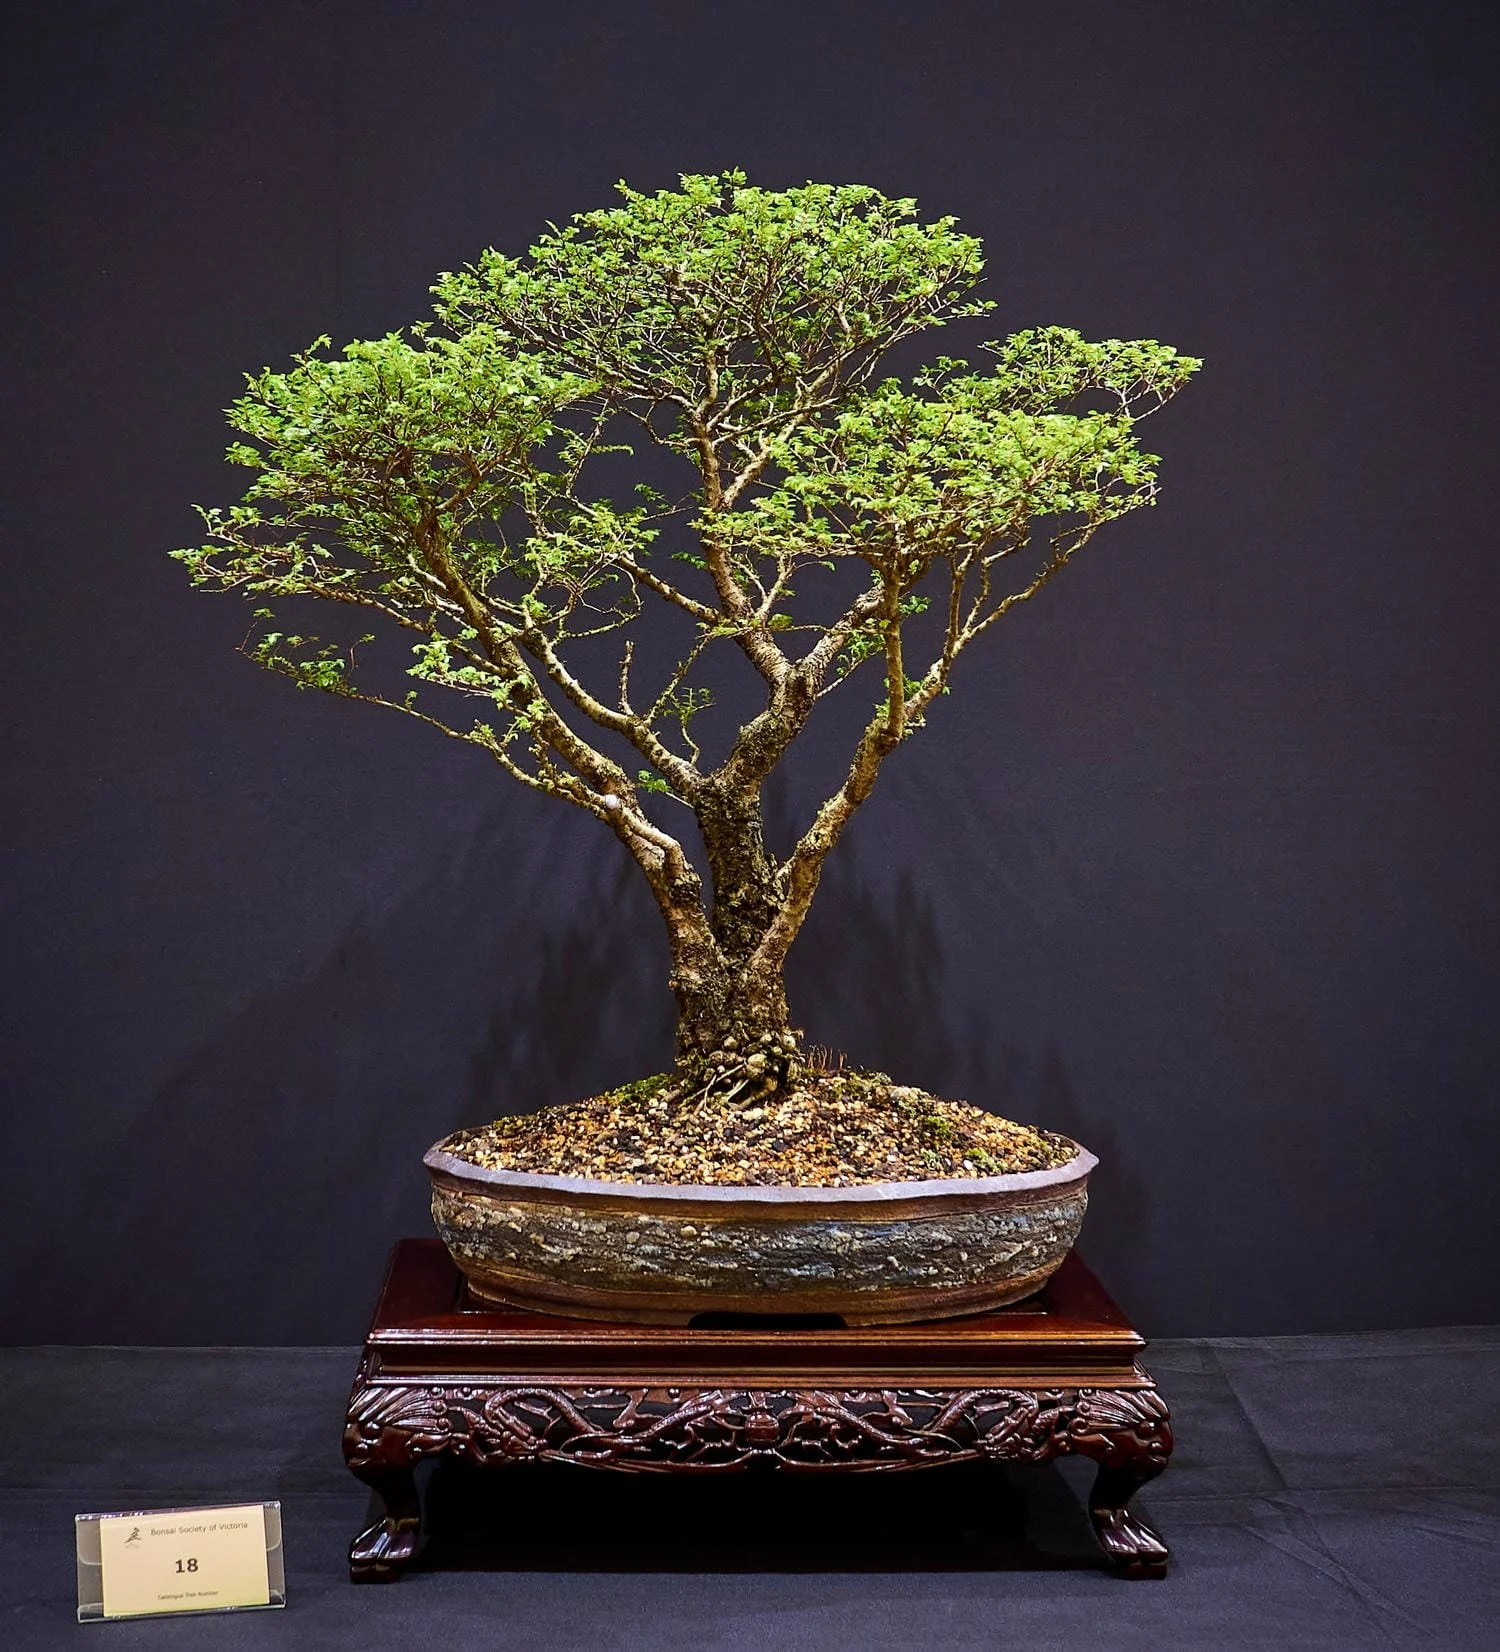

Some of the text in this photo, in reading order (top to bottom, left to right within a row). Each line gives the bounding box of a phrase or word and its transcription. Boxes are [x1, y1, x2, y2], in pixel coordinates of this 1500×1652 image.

[178, 1526, 206, 1534] Society
[218, 1522, 248, 1530] Victoria
[175, 1558, 199, 1574] 18
